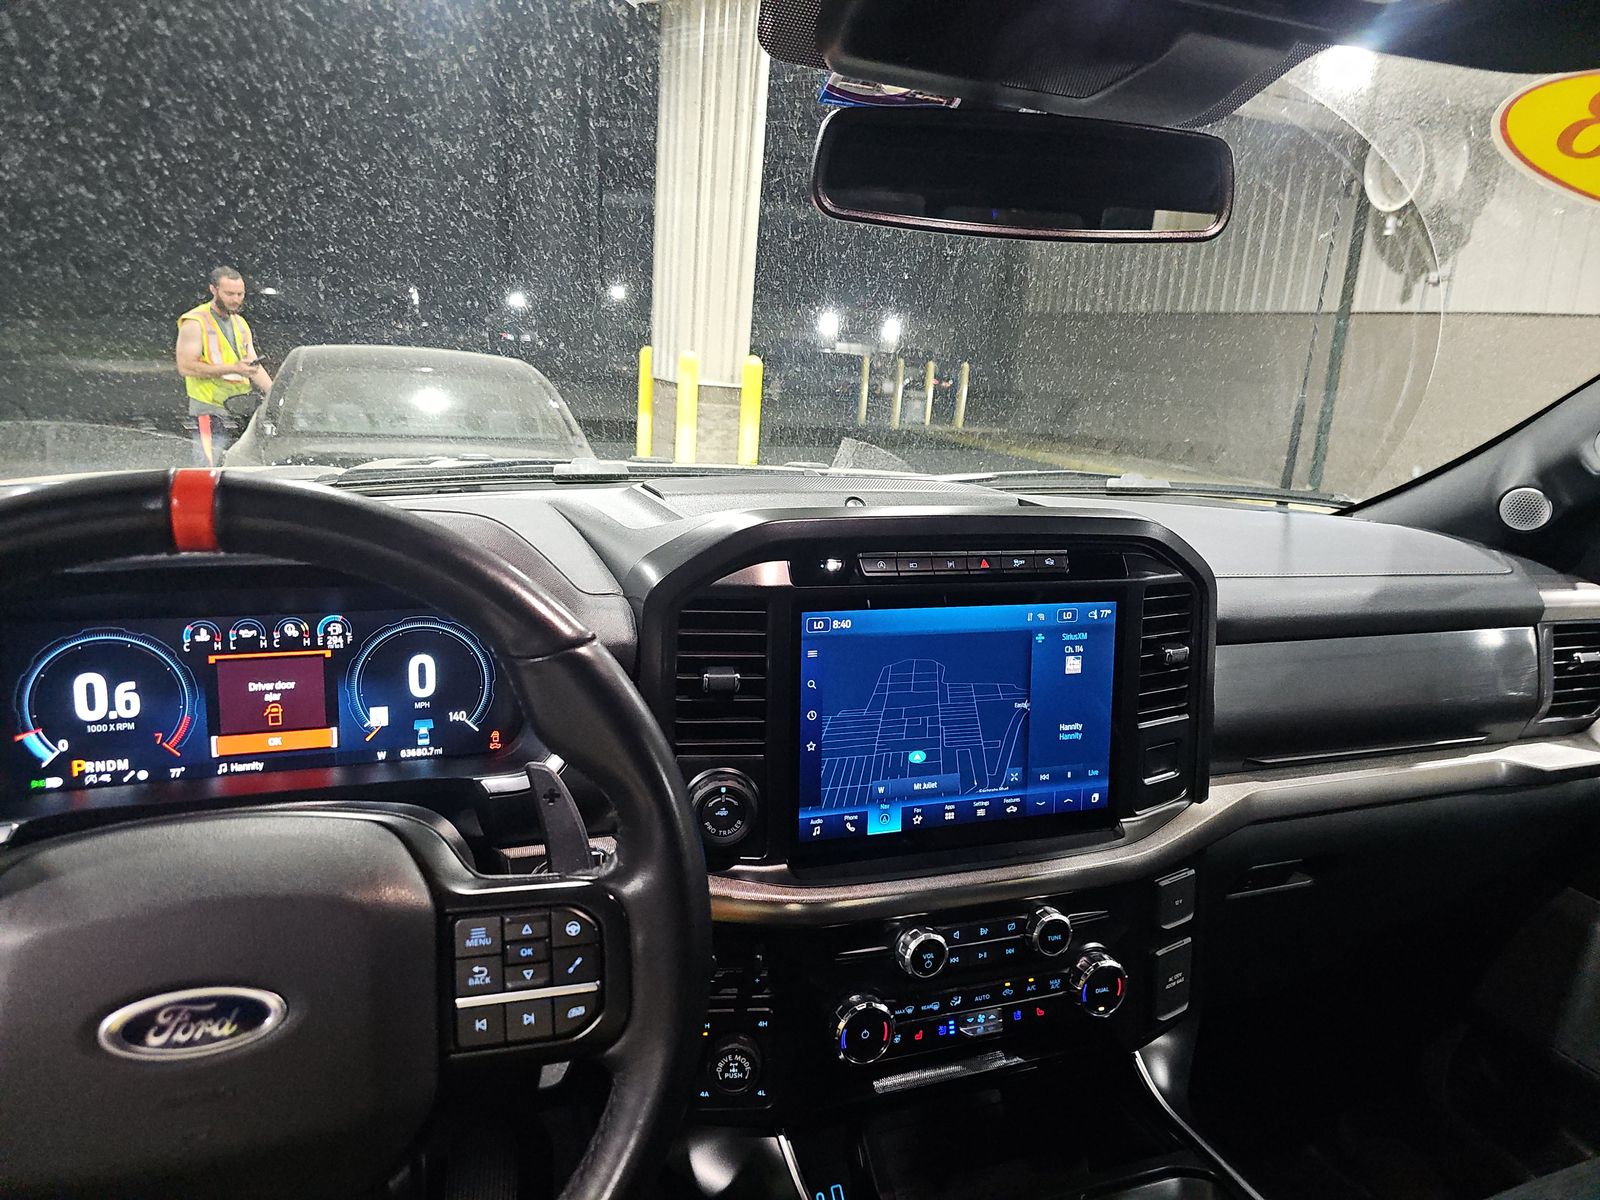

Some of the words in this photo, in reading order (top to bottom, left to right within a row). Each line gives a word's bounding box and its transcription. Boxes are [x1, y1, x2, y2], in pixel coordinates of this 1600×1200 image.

[813, 620, 824, 629] LO
[832, 620, 852, 629] 8:40
[1062, 632, 1088, 640] SiriusXM
[408, 654, 436, 698] 0
[248, 682, 274, 692] Driver
[275, 680, 296, 690] door
[72, 672, 140, 721] 0.6
[264, 692, 281, 702] ajar
[448, 711, 467, 722] 140
[86, 724, 108, 733] 1000
[109, 724, 115, 732] X
[116, 722, 135, 731] RPM
[1060, 722, 1083, 731] Hannity
[1059, 732, 1083, 740] Hannity
[268, 737, 282, 746] OK
[230, 760, 264, 773] Hannity
[704, 821, 716, 834] PRO
[719, 820, 743, 836] TRAILER
[465, 937, 492, 948] MENU
[1047, 934, 1062, 942] TUNE
[520, 948, 533, 957] OK
[468, 976, 491, 986] BACK
[1026, 984, 1037, 992] A/C
[974, 994, 991, 1002] AUTO
[146, 1002, 239, 1047] Ford
[716, 1054, 733, 1073] DRIVE
[734, 1054, 751, 1071] MODE
